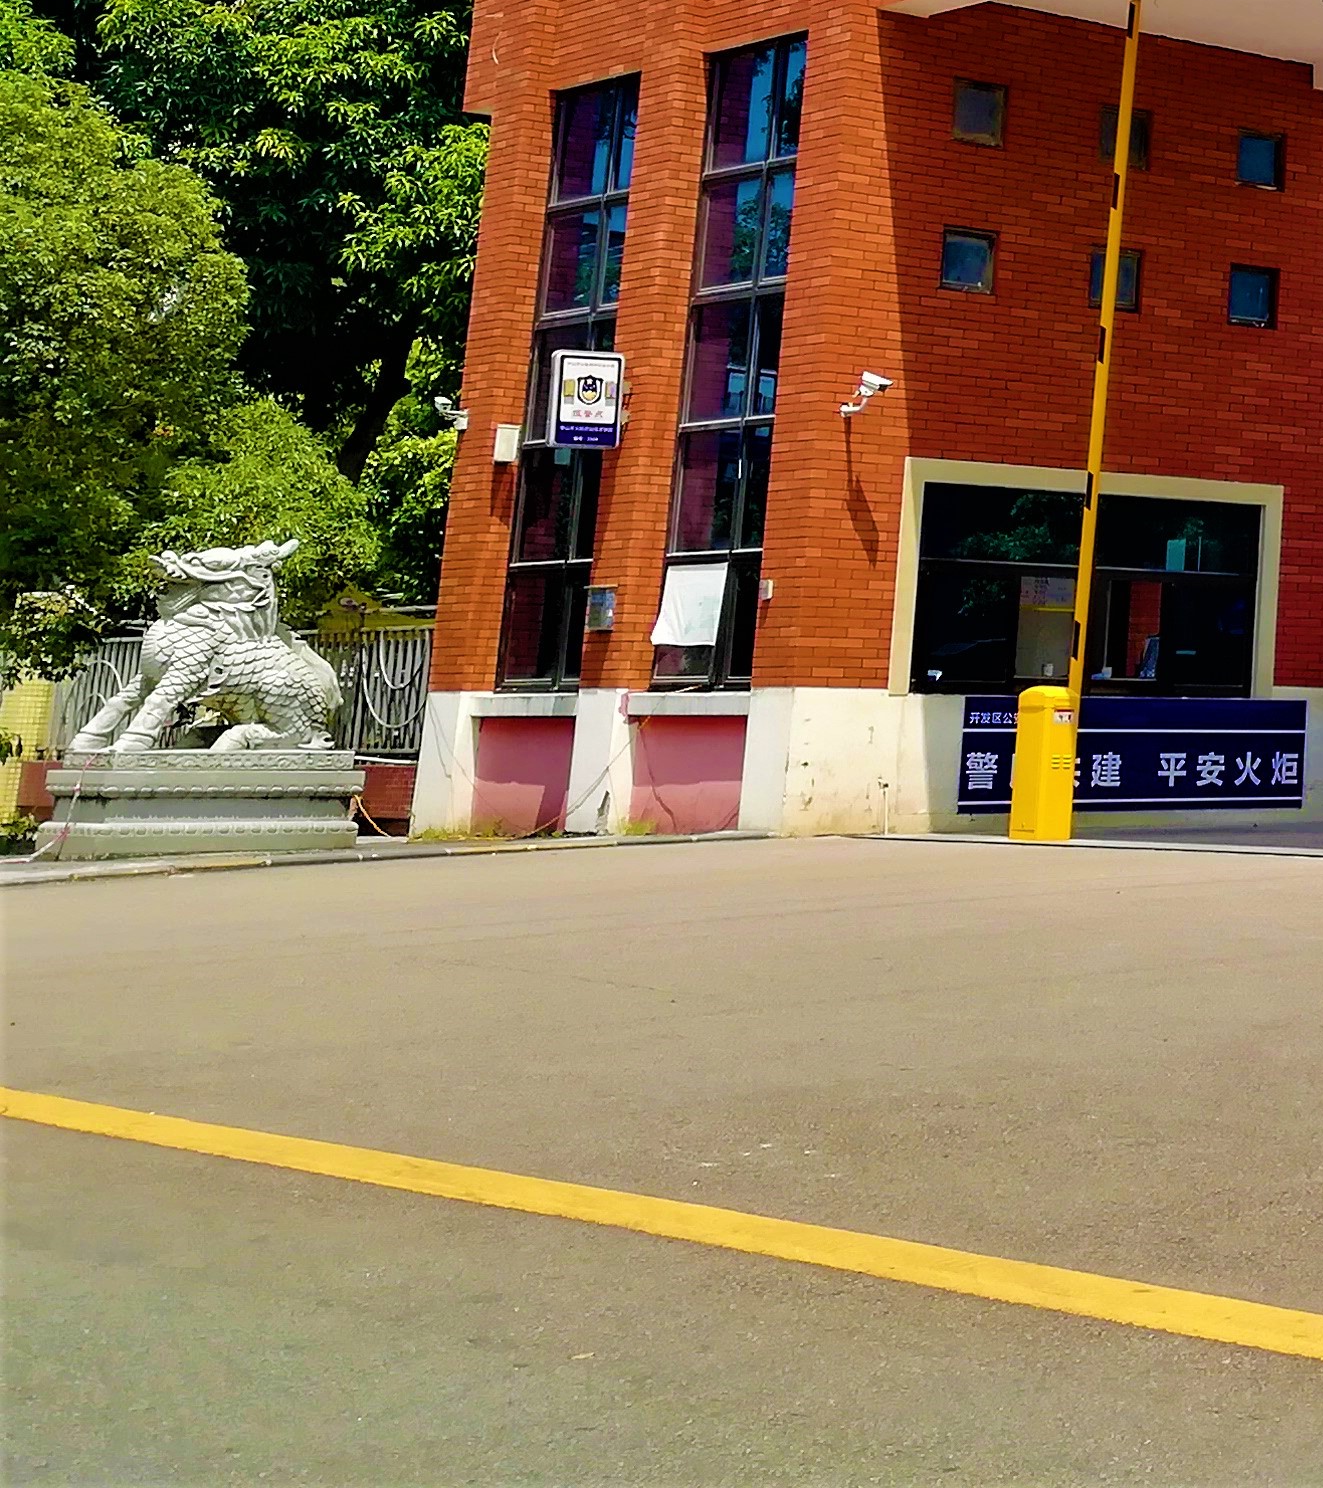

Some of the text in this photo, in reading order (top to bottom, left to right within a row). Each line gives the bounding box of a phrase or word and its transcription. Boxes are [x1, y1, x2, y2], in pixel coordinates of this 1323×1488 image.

[966, 751, 1299, 790] 警建 平安火炬
